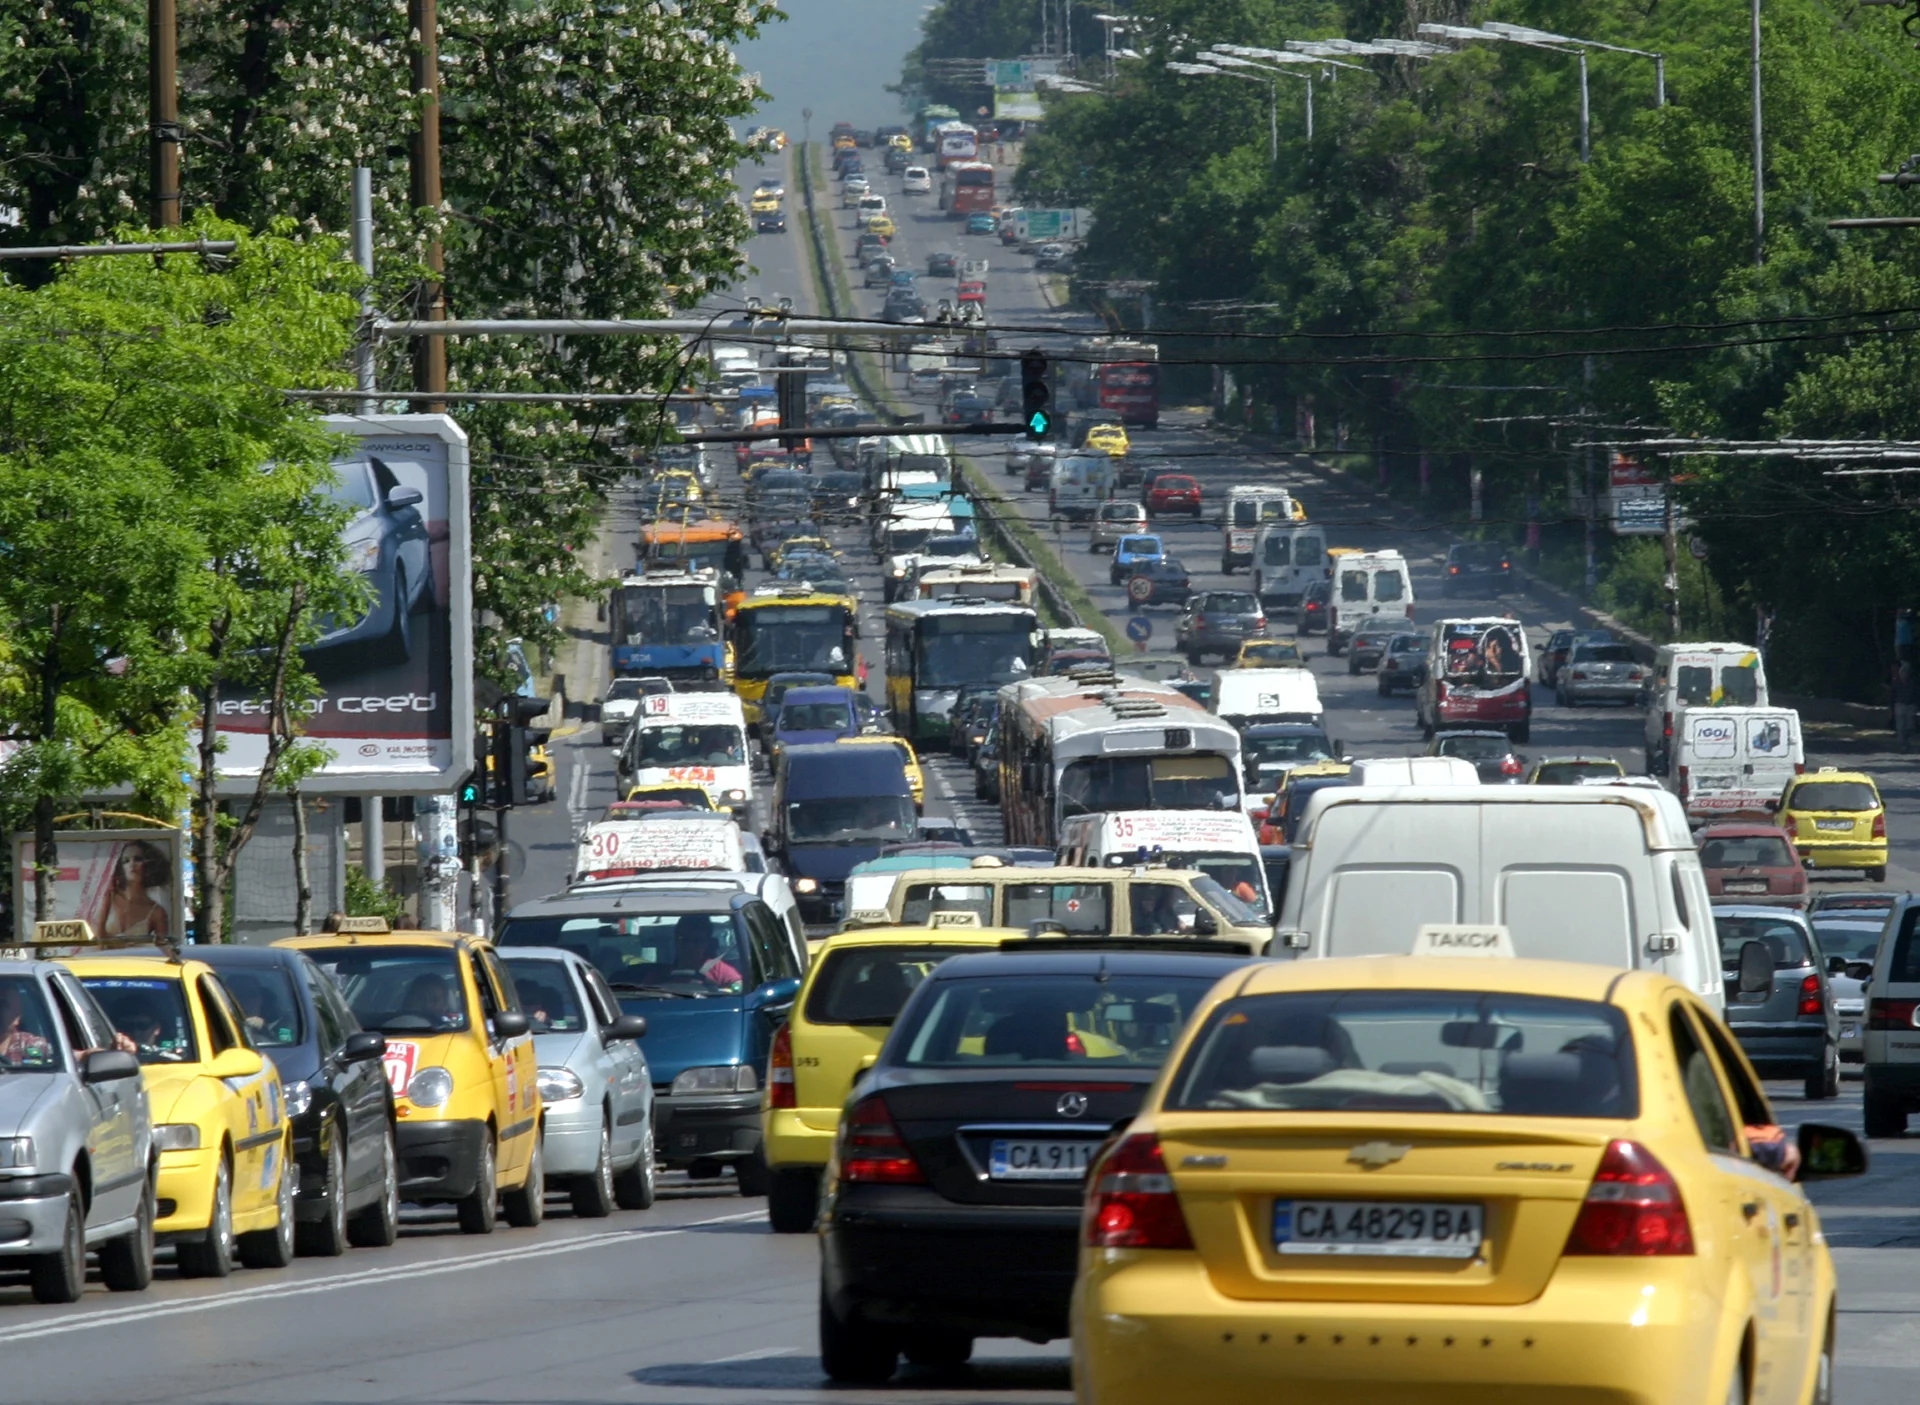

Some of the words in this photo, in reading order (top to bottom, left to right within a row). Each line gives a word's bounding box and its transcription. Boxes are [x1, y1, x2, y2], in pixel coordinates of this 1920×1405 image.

[337, 692, 436, 713] cee'd
[651, 698, 667, 713] 19
[1698, 727, 1730, 738] IGOL
[1114, 816, 1133, 837] 35
[592, 832, 619, 857] 30
[38, 924, 82, 938] ТАКСИ
[344, 919, 381, 928] ТАКСИ
[1426, 932, 1499, 948] ТАКСИ
[1010, 1145, 1040, 1169] CA
[1296, 1206, 1337, 1238] CA
[1346, 1207, 1426, 1240] 4829
[1432, 1209, 1473, 1242] BA
